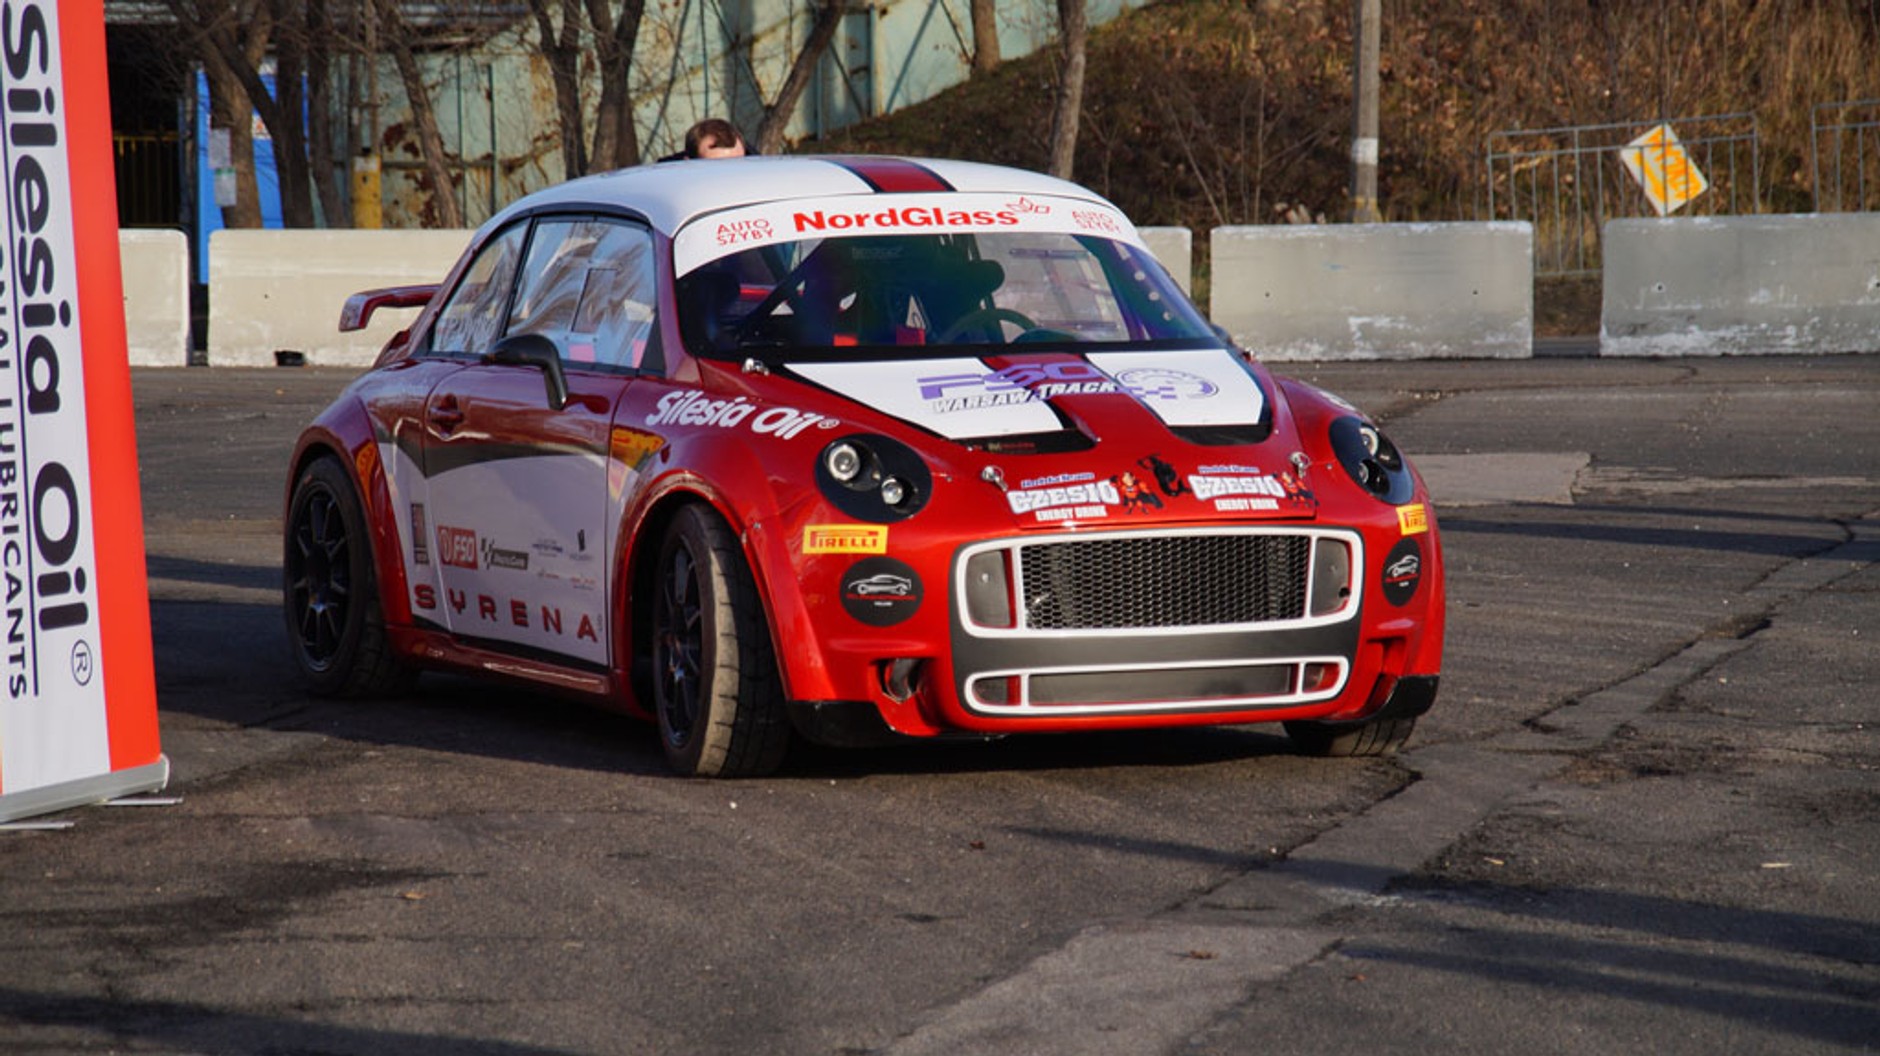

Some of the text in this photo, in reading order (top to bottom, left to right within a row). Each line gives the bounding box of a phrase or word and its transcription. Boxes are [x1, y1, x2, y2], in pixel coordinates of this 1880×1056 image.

[2, 3, 71, 416] Silesia
[793, 207, 1019, 233] NordGlass
[716, 228, 774, 246] SZYBY
[717, 219, 770, 235] AUTO
[645, 390, 757, 428] Silesia
[932, 381, 1119, 413] WARSAW TRACK
[1006, 480, 1120, 515] CZESIO
[33, 461, 89, 632] Oil
[809, 530, 880, 548] PIRELLI
[413, 582, 599, 644] SYRENA
